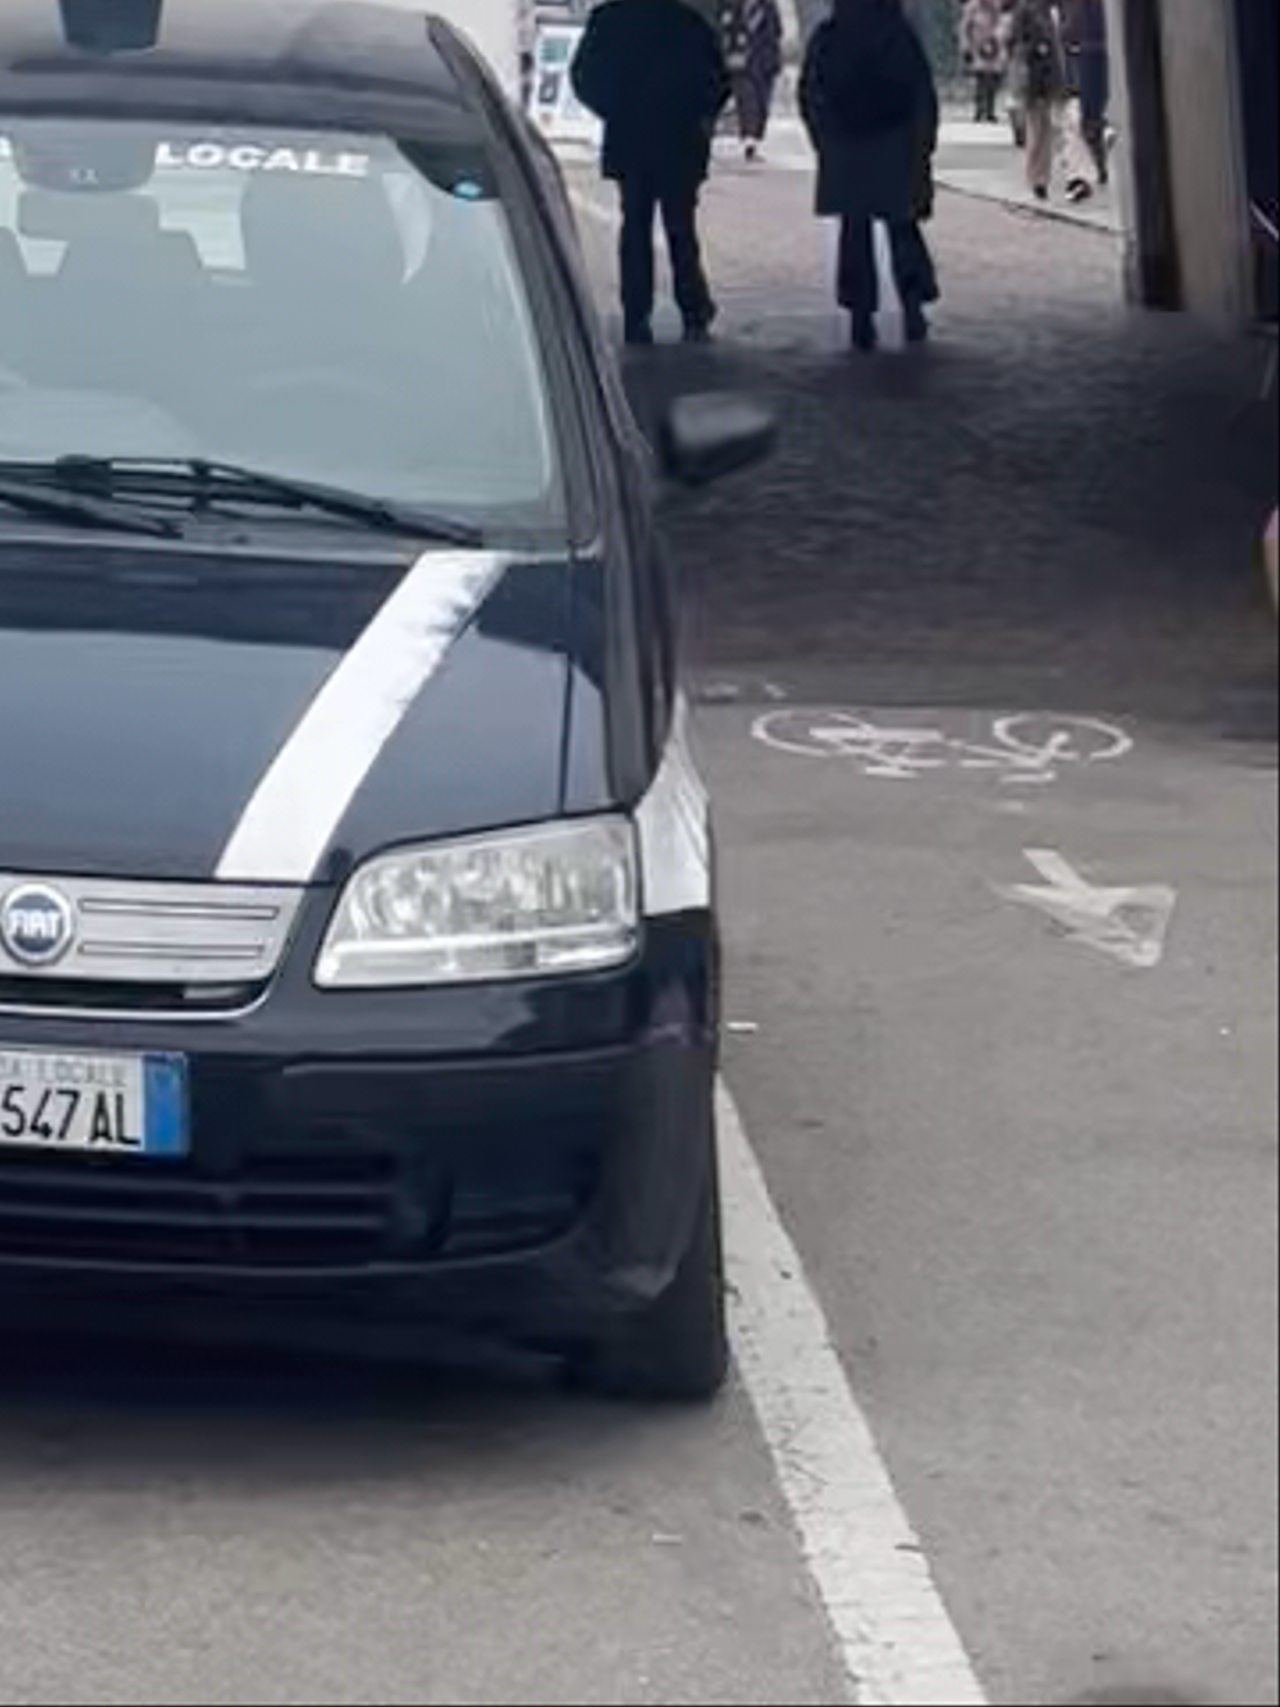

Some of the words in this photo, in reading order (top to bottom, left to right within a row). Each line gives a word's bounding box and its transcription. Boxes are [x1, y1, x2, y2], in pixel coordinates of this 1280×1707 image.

[154, 142, 369, 177] LOCALE
[0, 1085, 82, 1140] 547
[90, 1091, 142, 1146] AL
